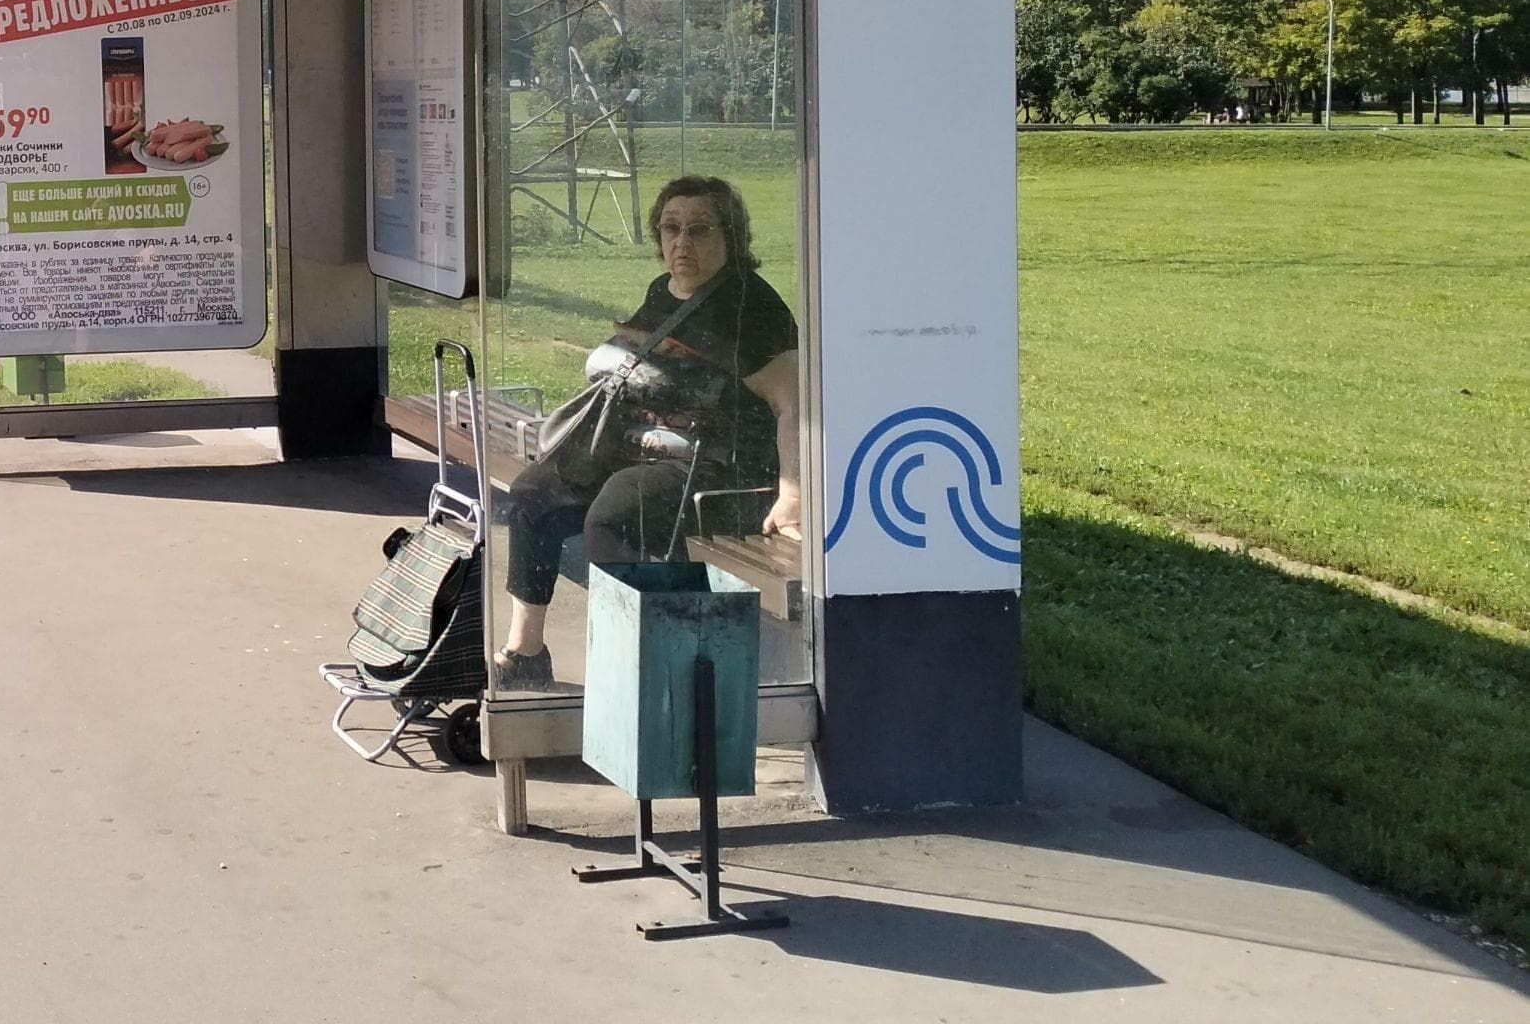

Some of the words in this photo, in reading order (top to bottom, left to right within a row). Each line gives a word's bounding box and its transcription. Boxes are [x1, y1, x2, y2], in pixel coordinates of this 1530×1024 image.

[116, 18, 146, 33] 20.08
[148, 16, 162, 27] по
[164, 4, 220, 25] 02.09.2024
[41, 163, 60, 173] 400
[12, 189, 35, 203] ЕЩЕ
[38, 187, 83, 201] БОЛЬШЕ
[86, 184, 122, 200] АКЦИЙ
[125, 186, 133, 196] И
[136, 183, 178, 197] СКИДОК
[191, 181, 207, 191] 16+
[13, 212, 27, 224] НА
[30, 210, 69, 223] НАШЕМ
[72, 206, 104, 221] САЙТЕ
[107, 203, 185, 221] AVOSKA.RU
[34, 243, 50, 253] ул.
[53, 238, 125, 251] Борисовские
[128, 238, 168, 248] пруды,
[170, 237, 181, 247] д.
[184, 235, 200, 245] 14,
[203, 234, 224, 245] стр.
[226, 233, 233, 243] 4
[11, 311, 36, 321] ООО
[47, 308, 122, 320] «Авоська-два»
[41, 318, 77, 331] пруды,
[79, 317, 102, 328] д.14,
[103, 315, 135, 327] корп.4
[136, 314, 165, 324] ОГРН
